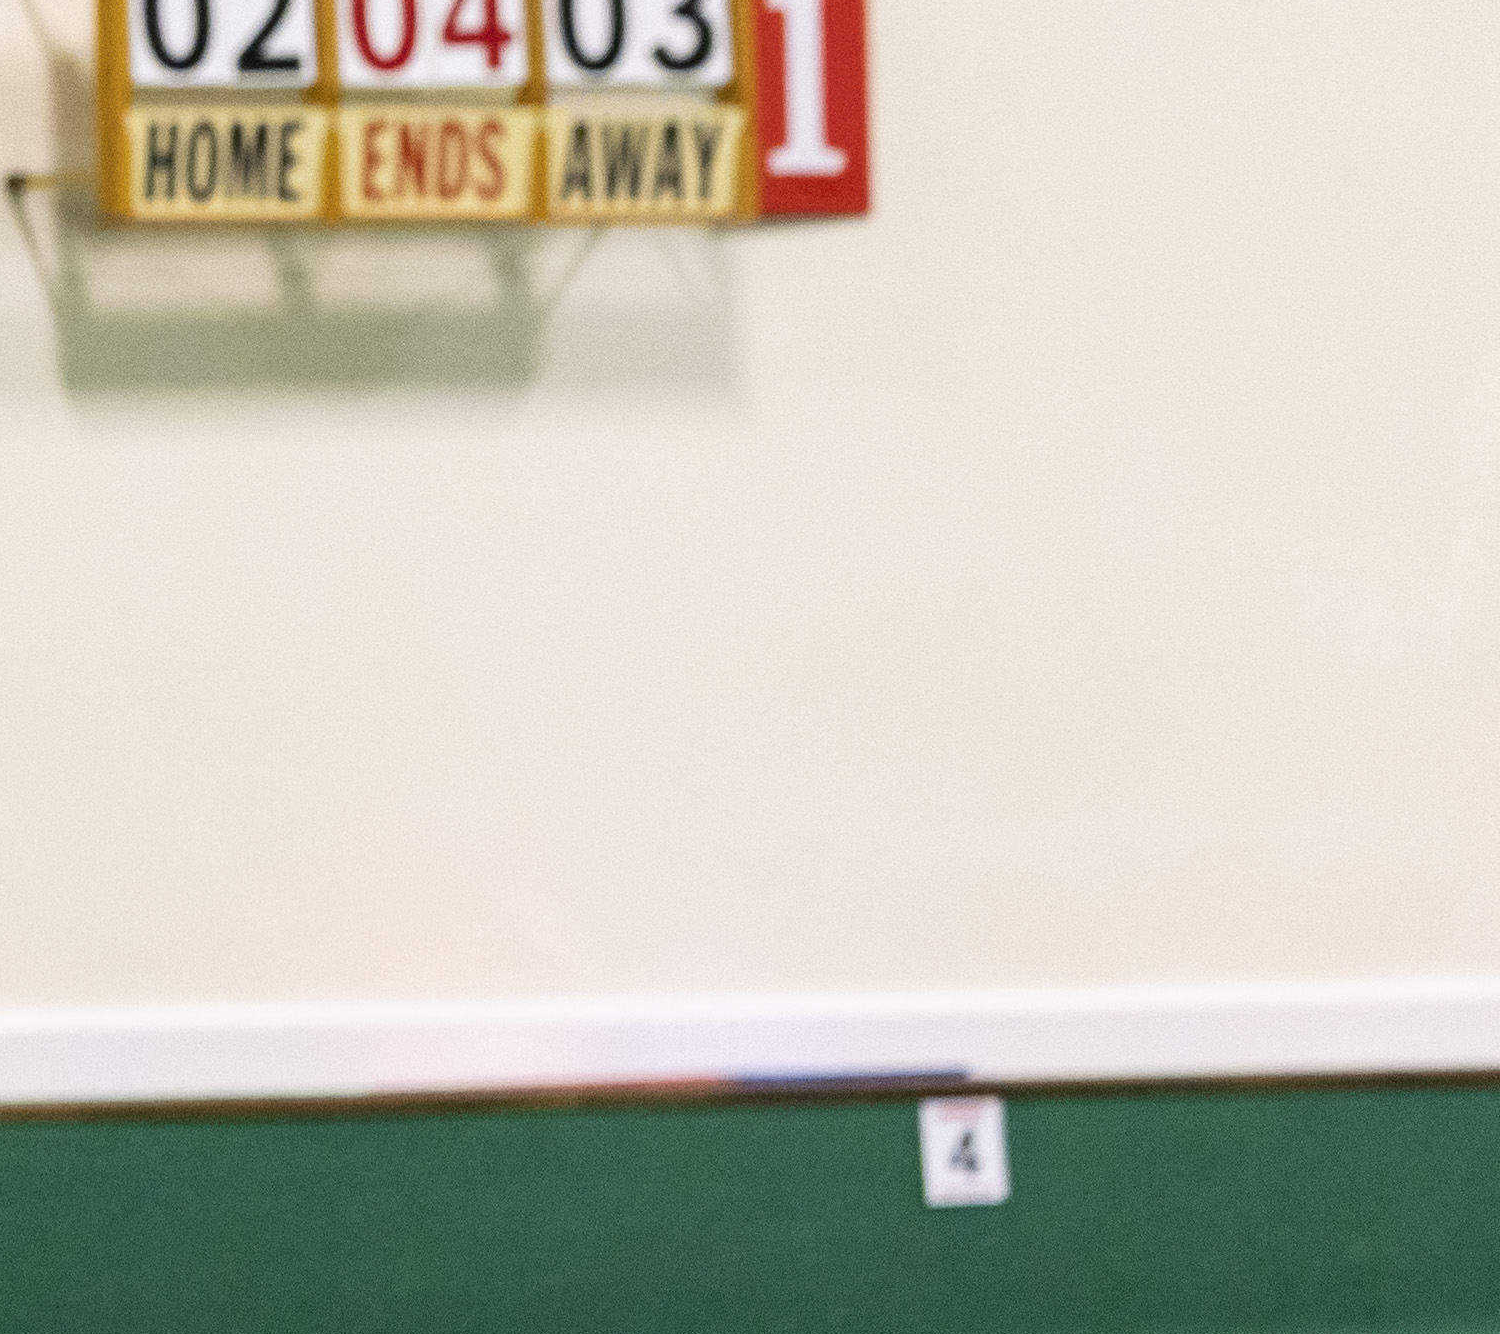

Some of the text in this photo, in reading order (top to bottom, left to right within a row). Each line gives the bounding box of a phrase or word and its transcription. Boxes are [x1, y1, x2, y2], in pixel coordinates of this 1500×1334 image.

[143, 119, 725, 202] HOME ENDS AWAY
[950, 1130, 980, 1175] 4
